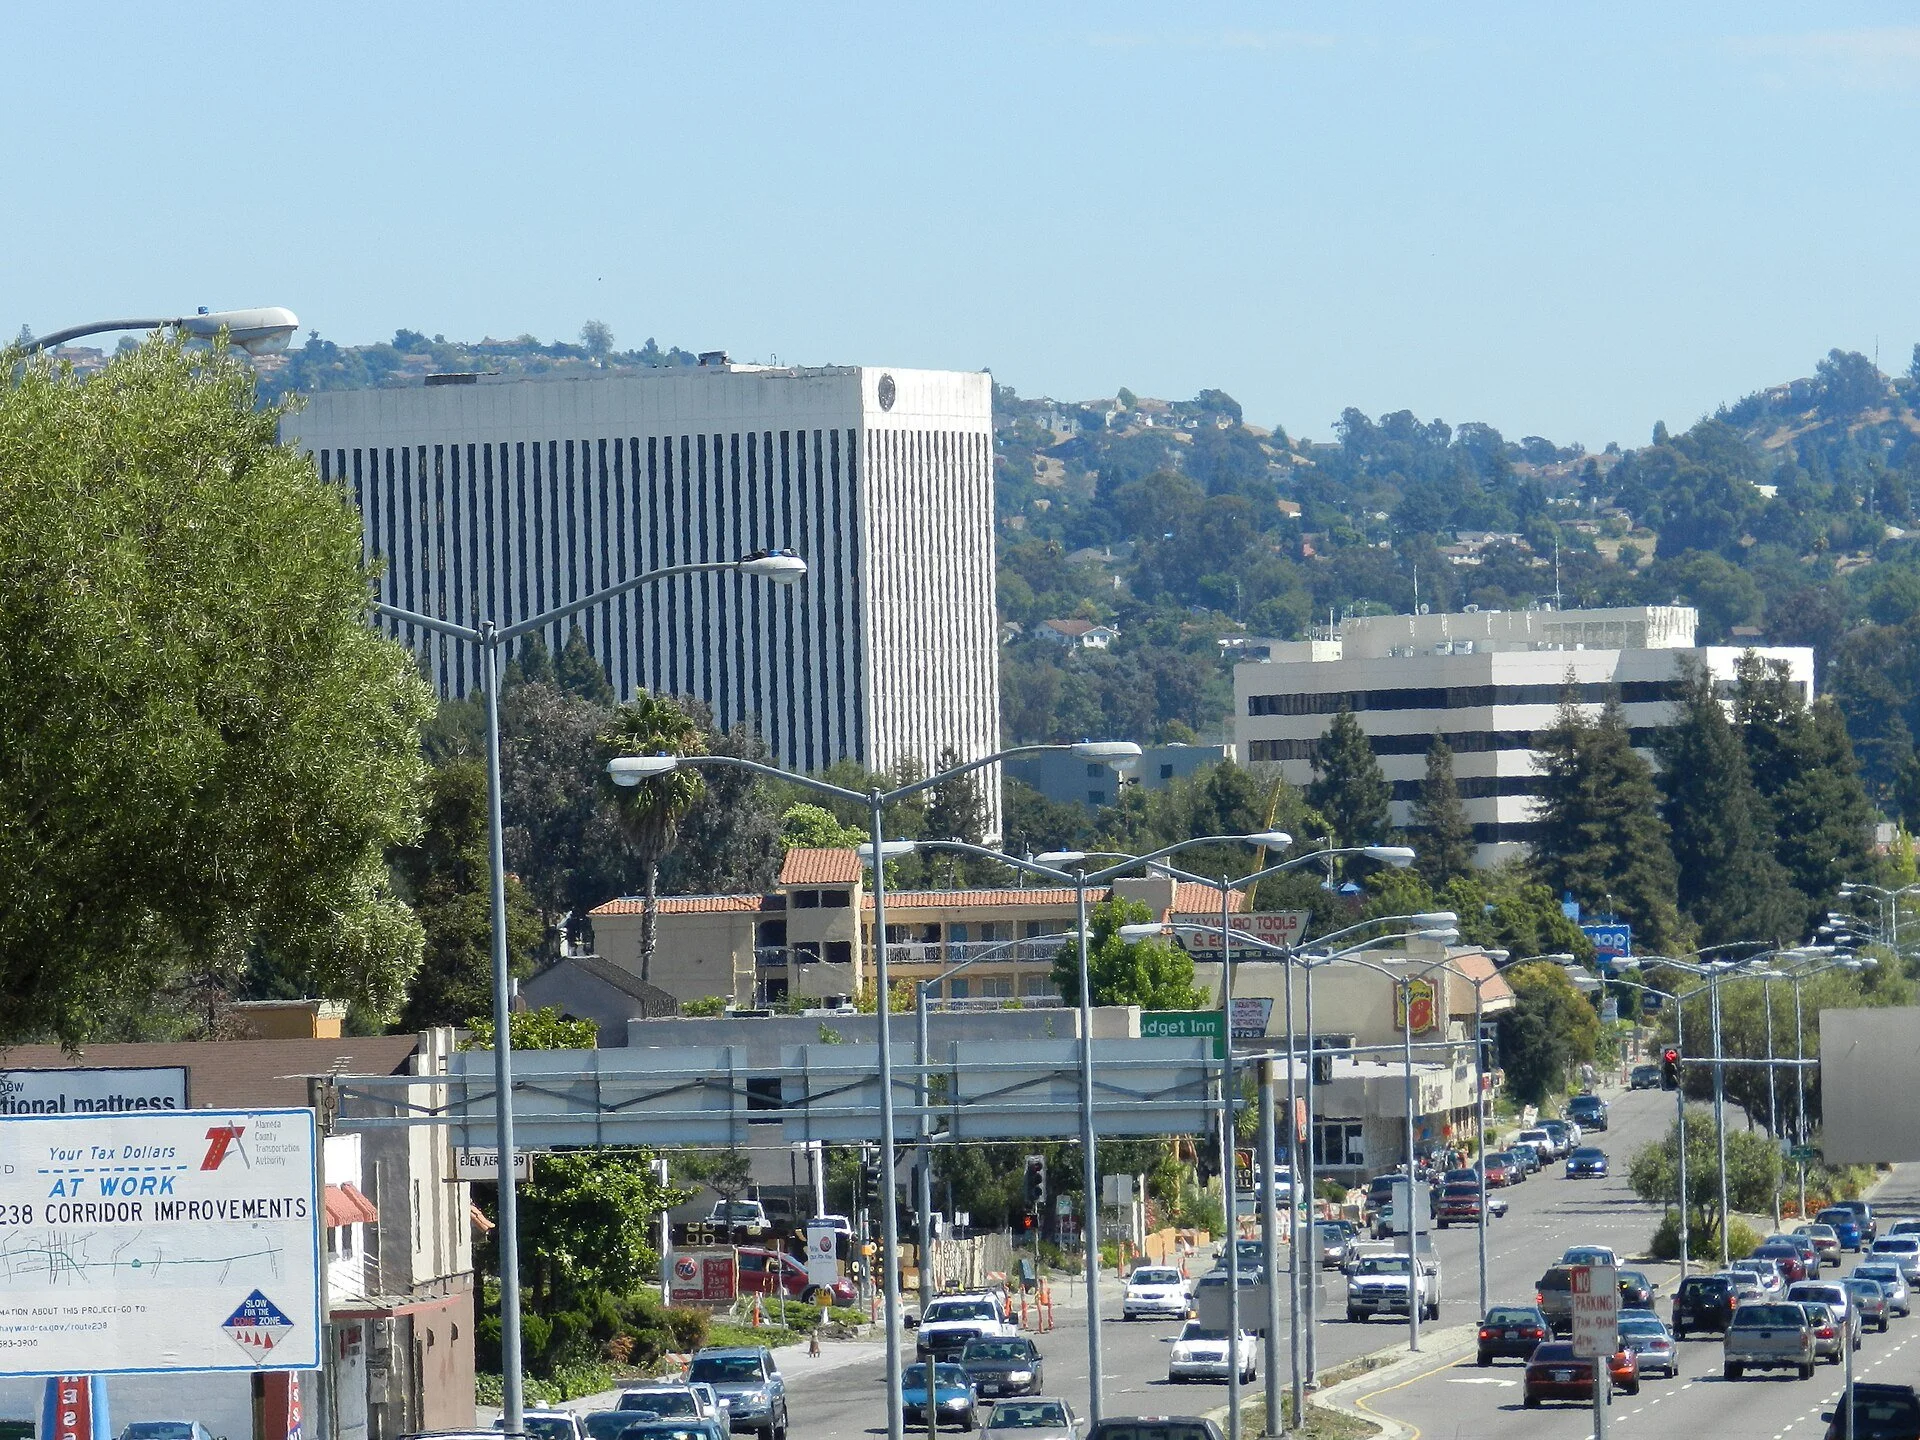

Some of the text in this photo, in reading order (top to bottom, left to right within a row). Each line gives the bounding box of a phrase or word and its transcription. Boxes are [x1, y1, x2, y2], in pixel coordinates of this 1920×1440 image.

[1256, 916, 1297, 930] TOOLS
[1194, 933, 1204, 947] &
[1141, 1019, 1216, 1036] udget Inn
[74, 1094, 176, 1112] mattress
[50, 1145, 176, 1160] Your Tax Dollars
[460, 1155, 480, 1167] EDEN
[48, 1175, 177, 1198] AT WORK
[45, 1202, 143, 1224] CORRIDOR
[154, 1198, 307, 1221] IMPROVEMENTS
[678, 1257, 696, 1277] 76
[1576, 1271, 1590, 1293] NO
[32, 1307, 58, 1316] ABOUT
[63, 1306, 79, 1315] THIS
[245, 1299, 267, 1308] SLOW
[1576, 1295, 1613, 1312] PARKING
[258, 1308, 269, 1316] THE
[259, 1316, 281, 1325] ZONE
